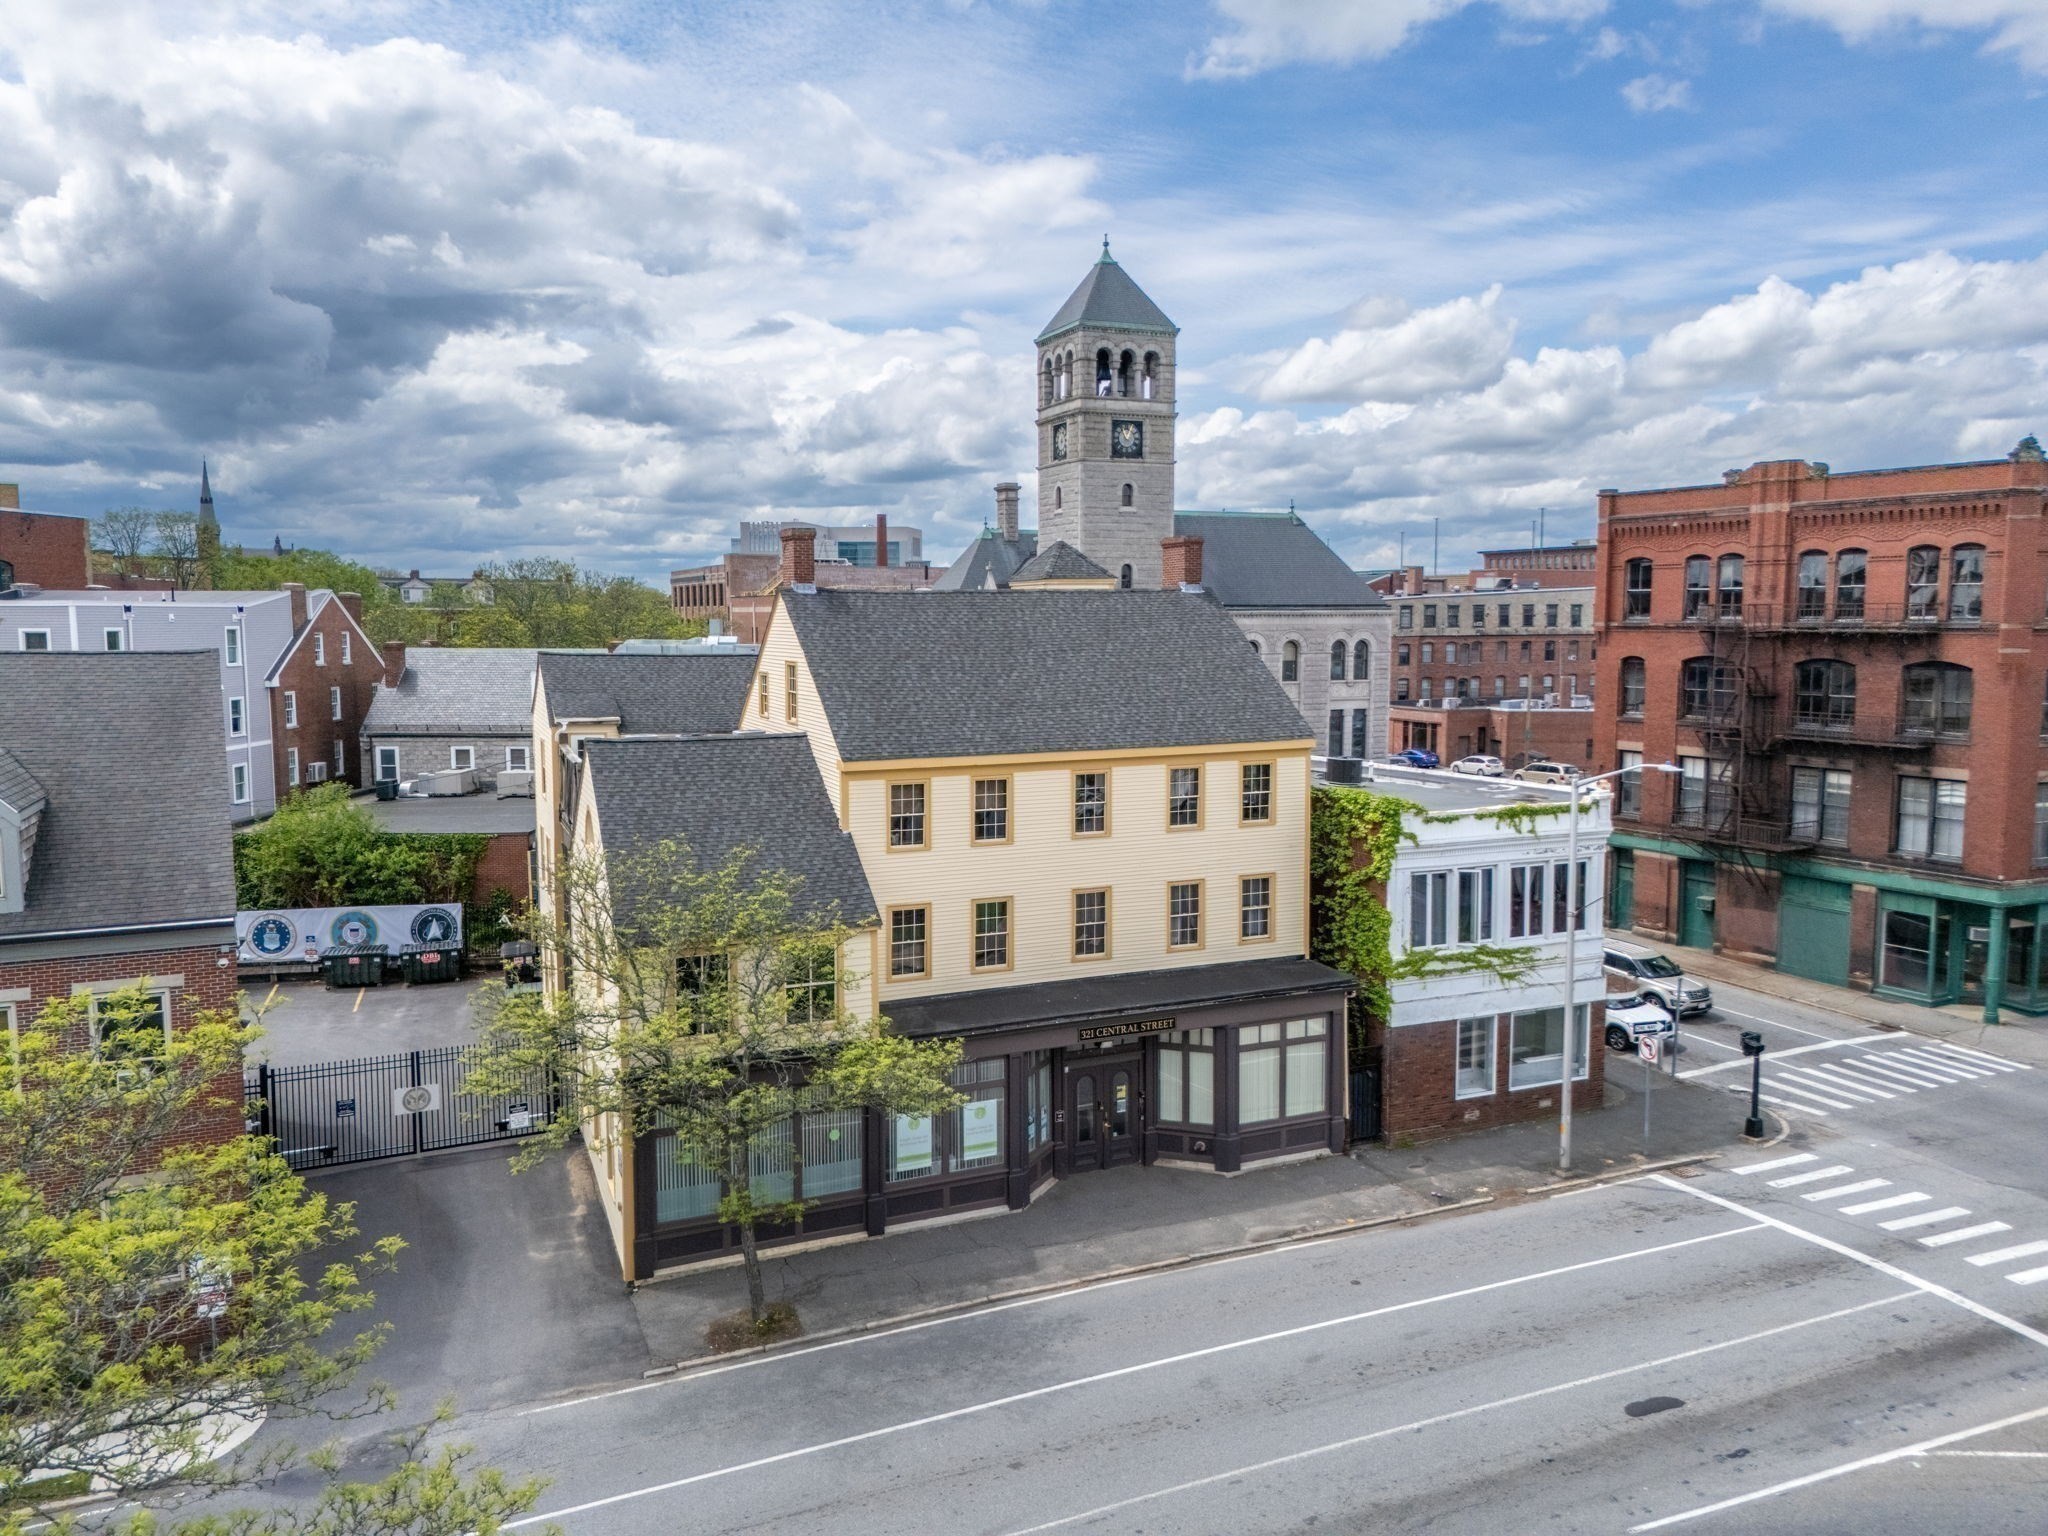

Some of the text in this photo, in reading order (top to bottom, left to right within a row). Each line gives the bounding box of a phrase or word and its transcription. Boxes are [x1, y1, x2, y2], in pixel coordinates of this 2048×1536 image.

[1081, 1019, 1175, 1039] 321 CENTRAL STREET
